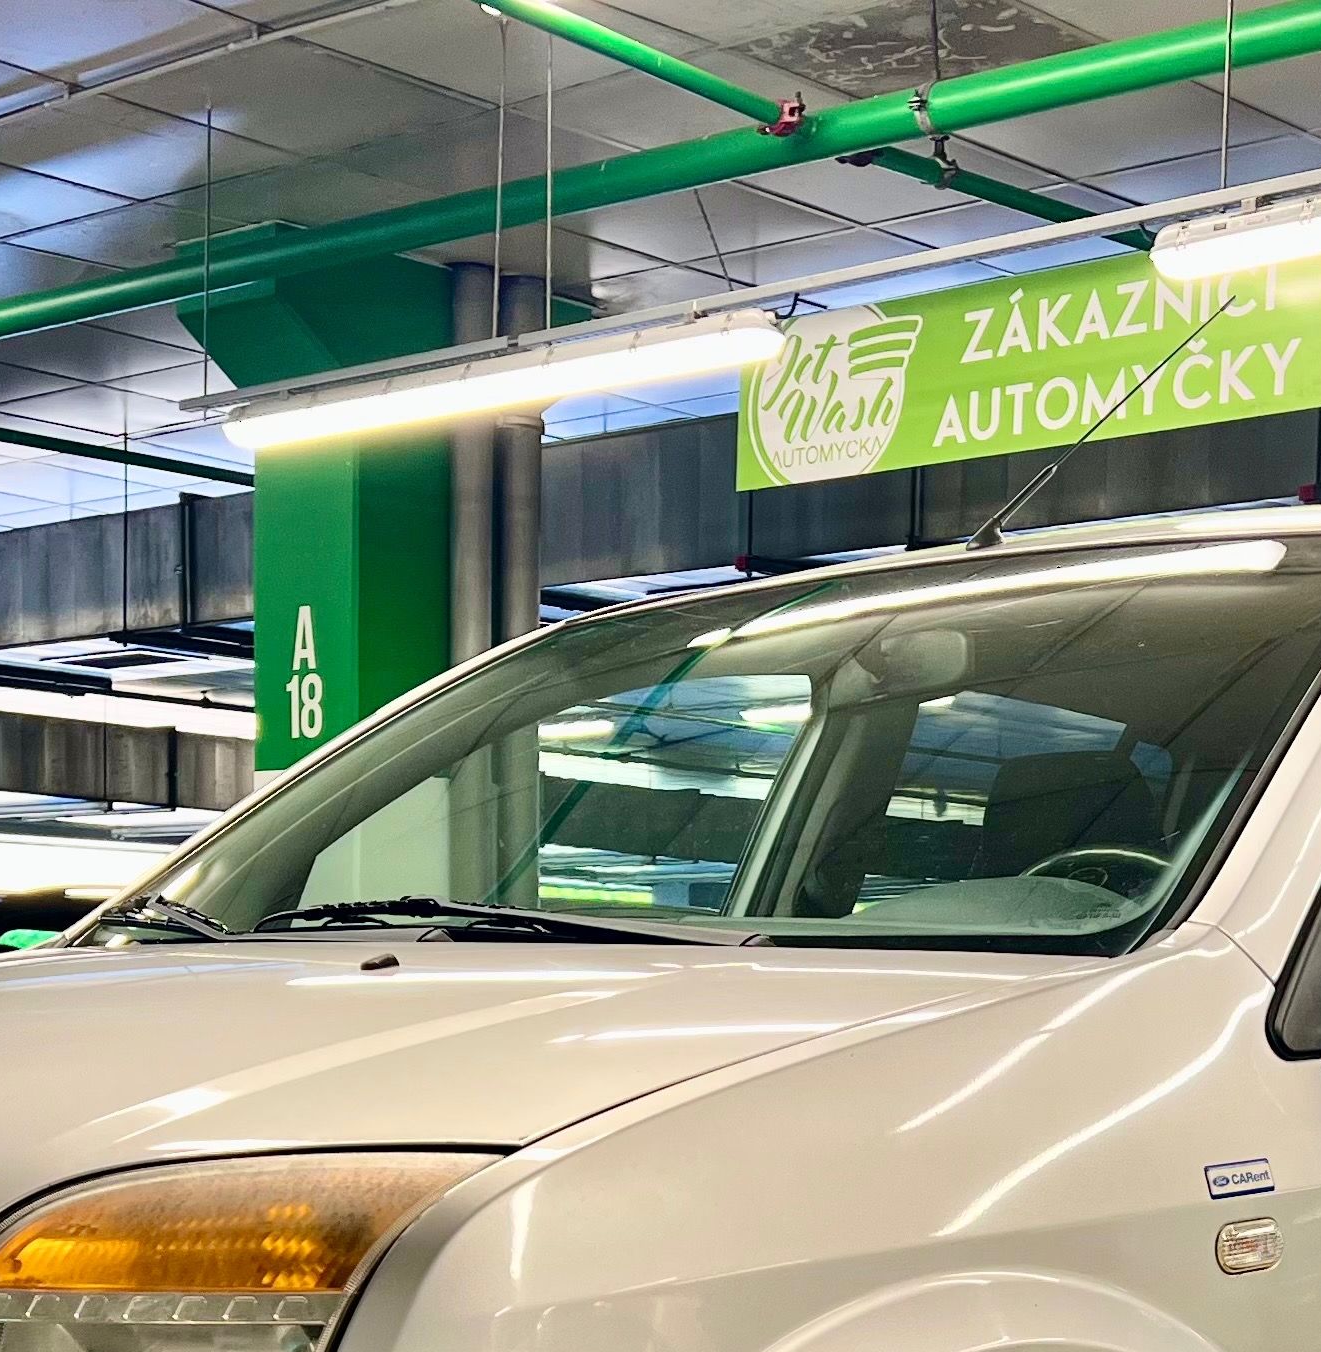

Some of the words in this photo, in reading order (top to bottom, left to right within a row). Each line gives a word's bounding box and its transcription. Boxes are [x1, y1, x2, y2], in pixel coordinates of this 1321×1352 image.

[762, 334, 844, 411] Jet
[779, 369, 895, 444] Wash
[932, 337, 1303, 448] AUTOMYČKY
[292, 605, 317, 671] A
[285, 673, 323, 739] 18
[1231, 1170, 1270, 1185] CARent
